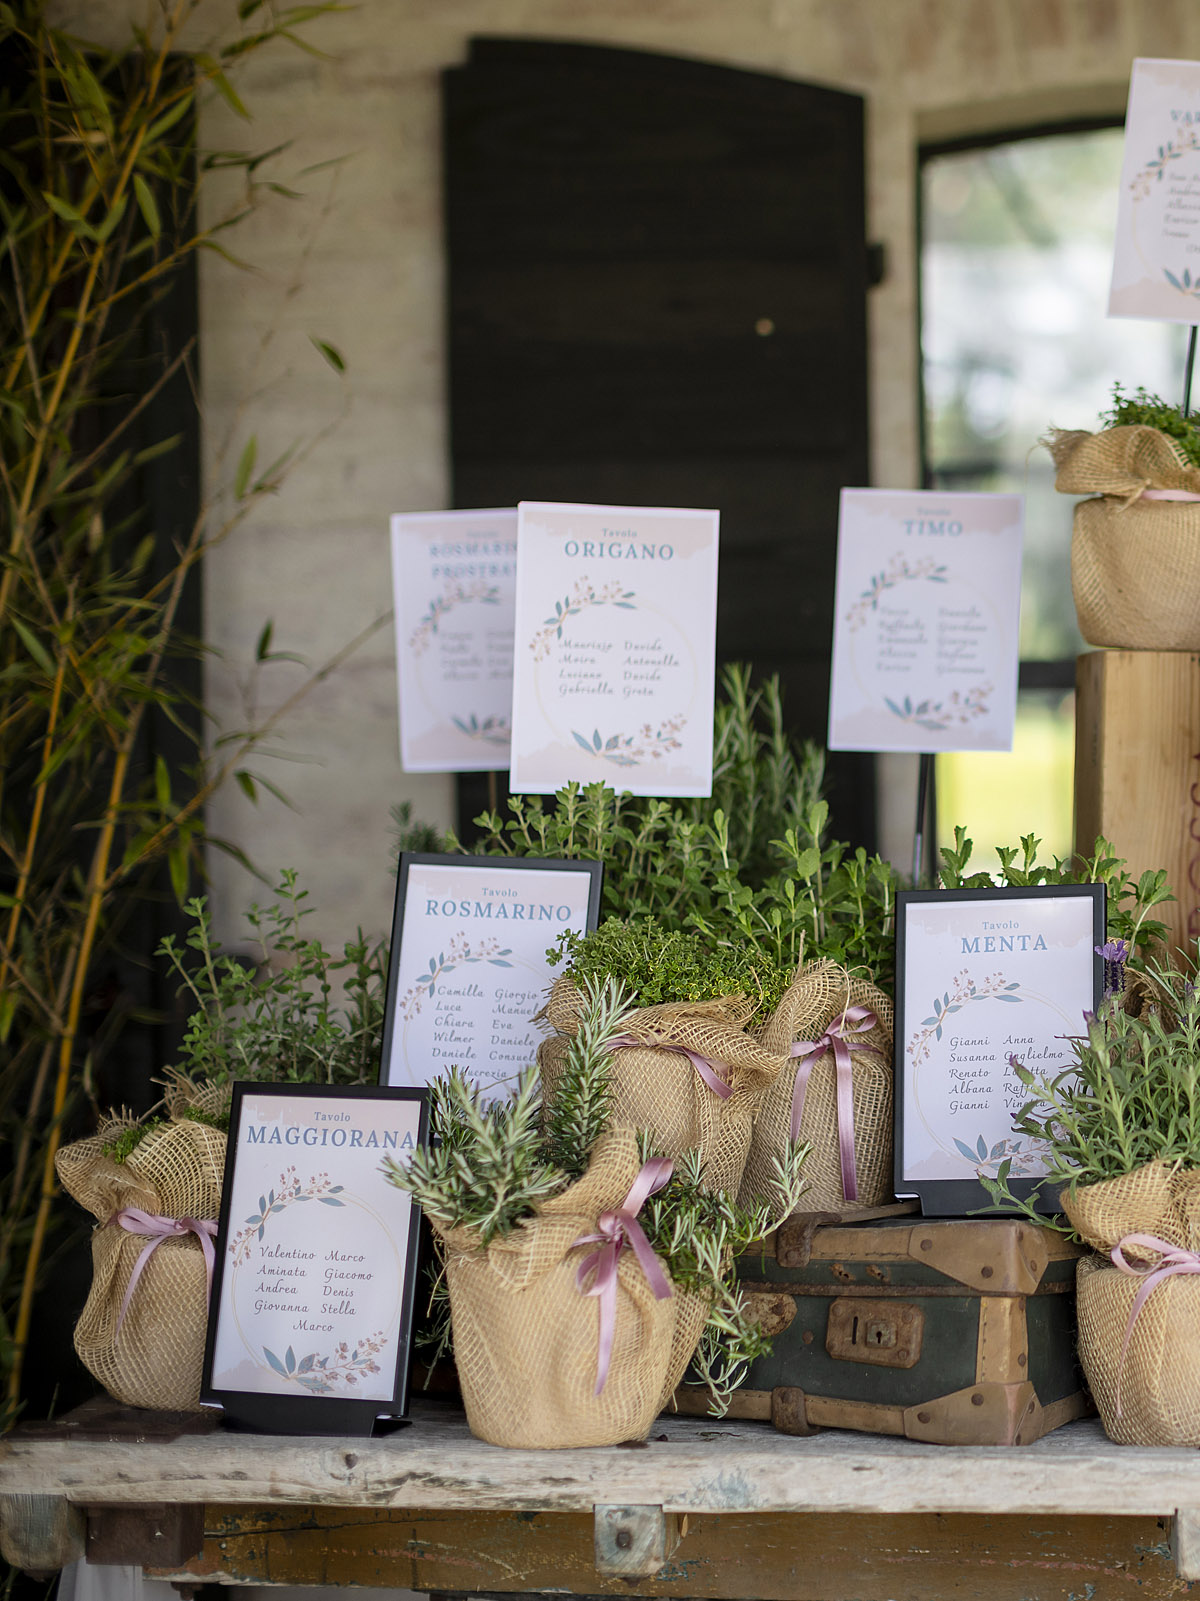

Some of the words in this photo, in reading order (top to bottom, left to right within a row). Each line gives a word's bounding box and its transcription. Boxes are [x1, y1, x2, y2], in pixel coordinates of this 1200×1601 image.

[601, 527, 637, 539] Tavolo
[904, 520, 963, 536] TIMO
[564, 541, 675, 561] ORIGANO
[482, 888, 518, 897] Tavolo
[425, 900, 572, 922] ROSMARINO
[982, 920, 1019, 930] Tavolo
[961, 934, 1047, 953] MENTA
[437, 984, 484, 997] Camilla
[495, 988, 538, 1005] Giorgio
[435, 1001, 462, 1011] Luca
[434, 1013, 474, 1028] Chiara
[492, 1019, 512, 1029] Eva
[433, 1030, 475, 1043] Wilmer
[490, 1034, 535, 1046] Daniele
[1003, 1035, 1035, 1045] Anna
[949, 1035, 990, 1053] Gianni
[432, 1047, 477, 1059] Daniele
[489, 1050, 536, 1061] Consuel
[949, 1051, 997, 1063] Susanna
[949, 1068, 991, 1080] Renato
[1003, 1065, 1048, 1077] Lotta
[949, 1081, 994, 1094] Albana
[949, 1099, 990, 1114] Gianni
[314, 1111, 351, 1122] Tavolo
[247, 1125, 415, 1149] MAGGIORANA
[260, 1245, 316, 1261] Valentino
[325, 1250, 366, 1263] Marco
[257, 1265, 307, 1277] Aminata
[324, 1267, 373, 1282] Giacomo
[255, 1278, 298, 1294] Andrea
[323, 1285, 355, 1298] Denis
[254, 1299, 310, 1315] Giovanna
[320, 1300, 357, 1316] Stella
[293, 1319, 334, 1332] Marco
